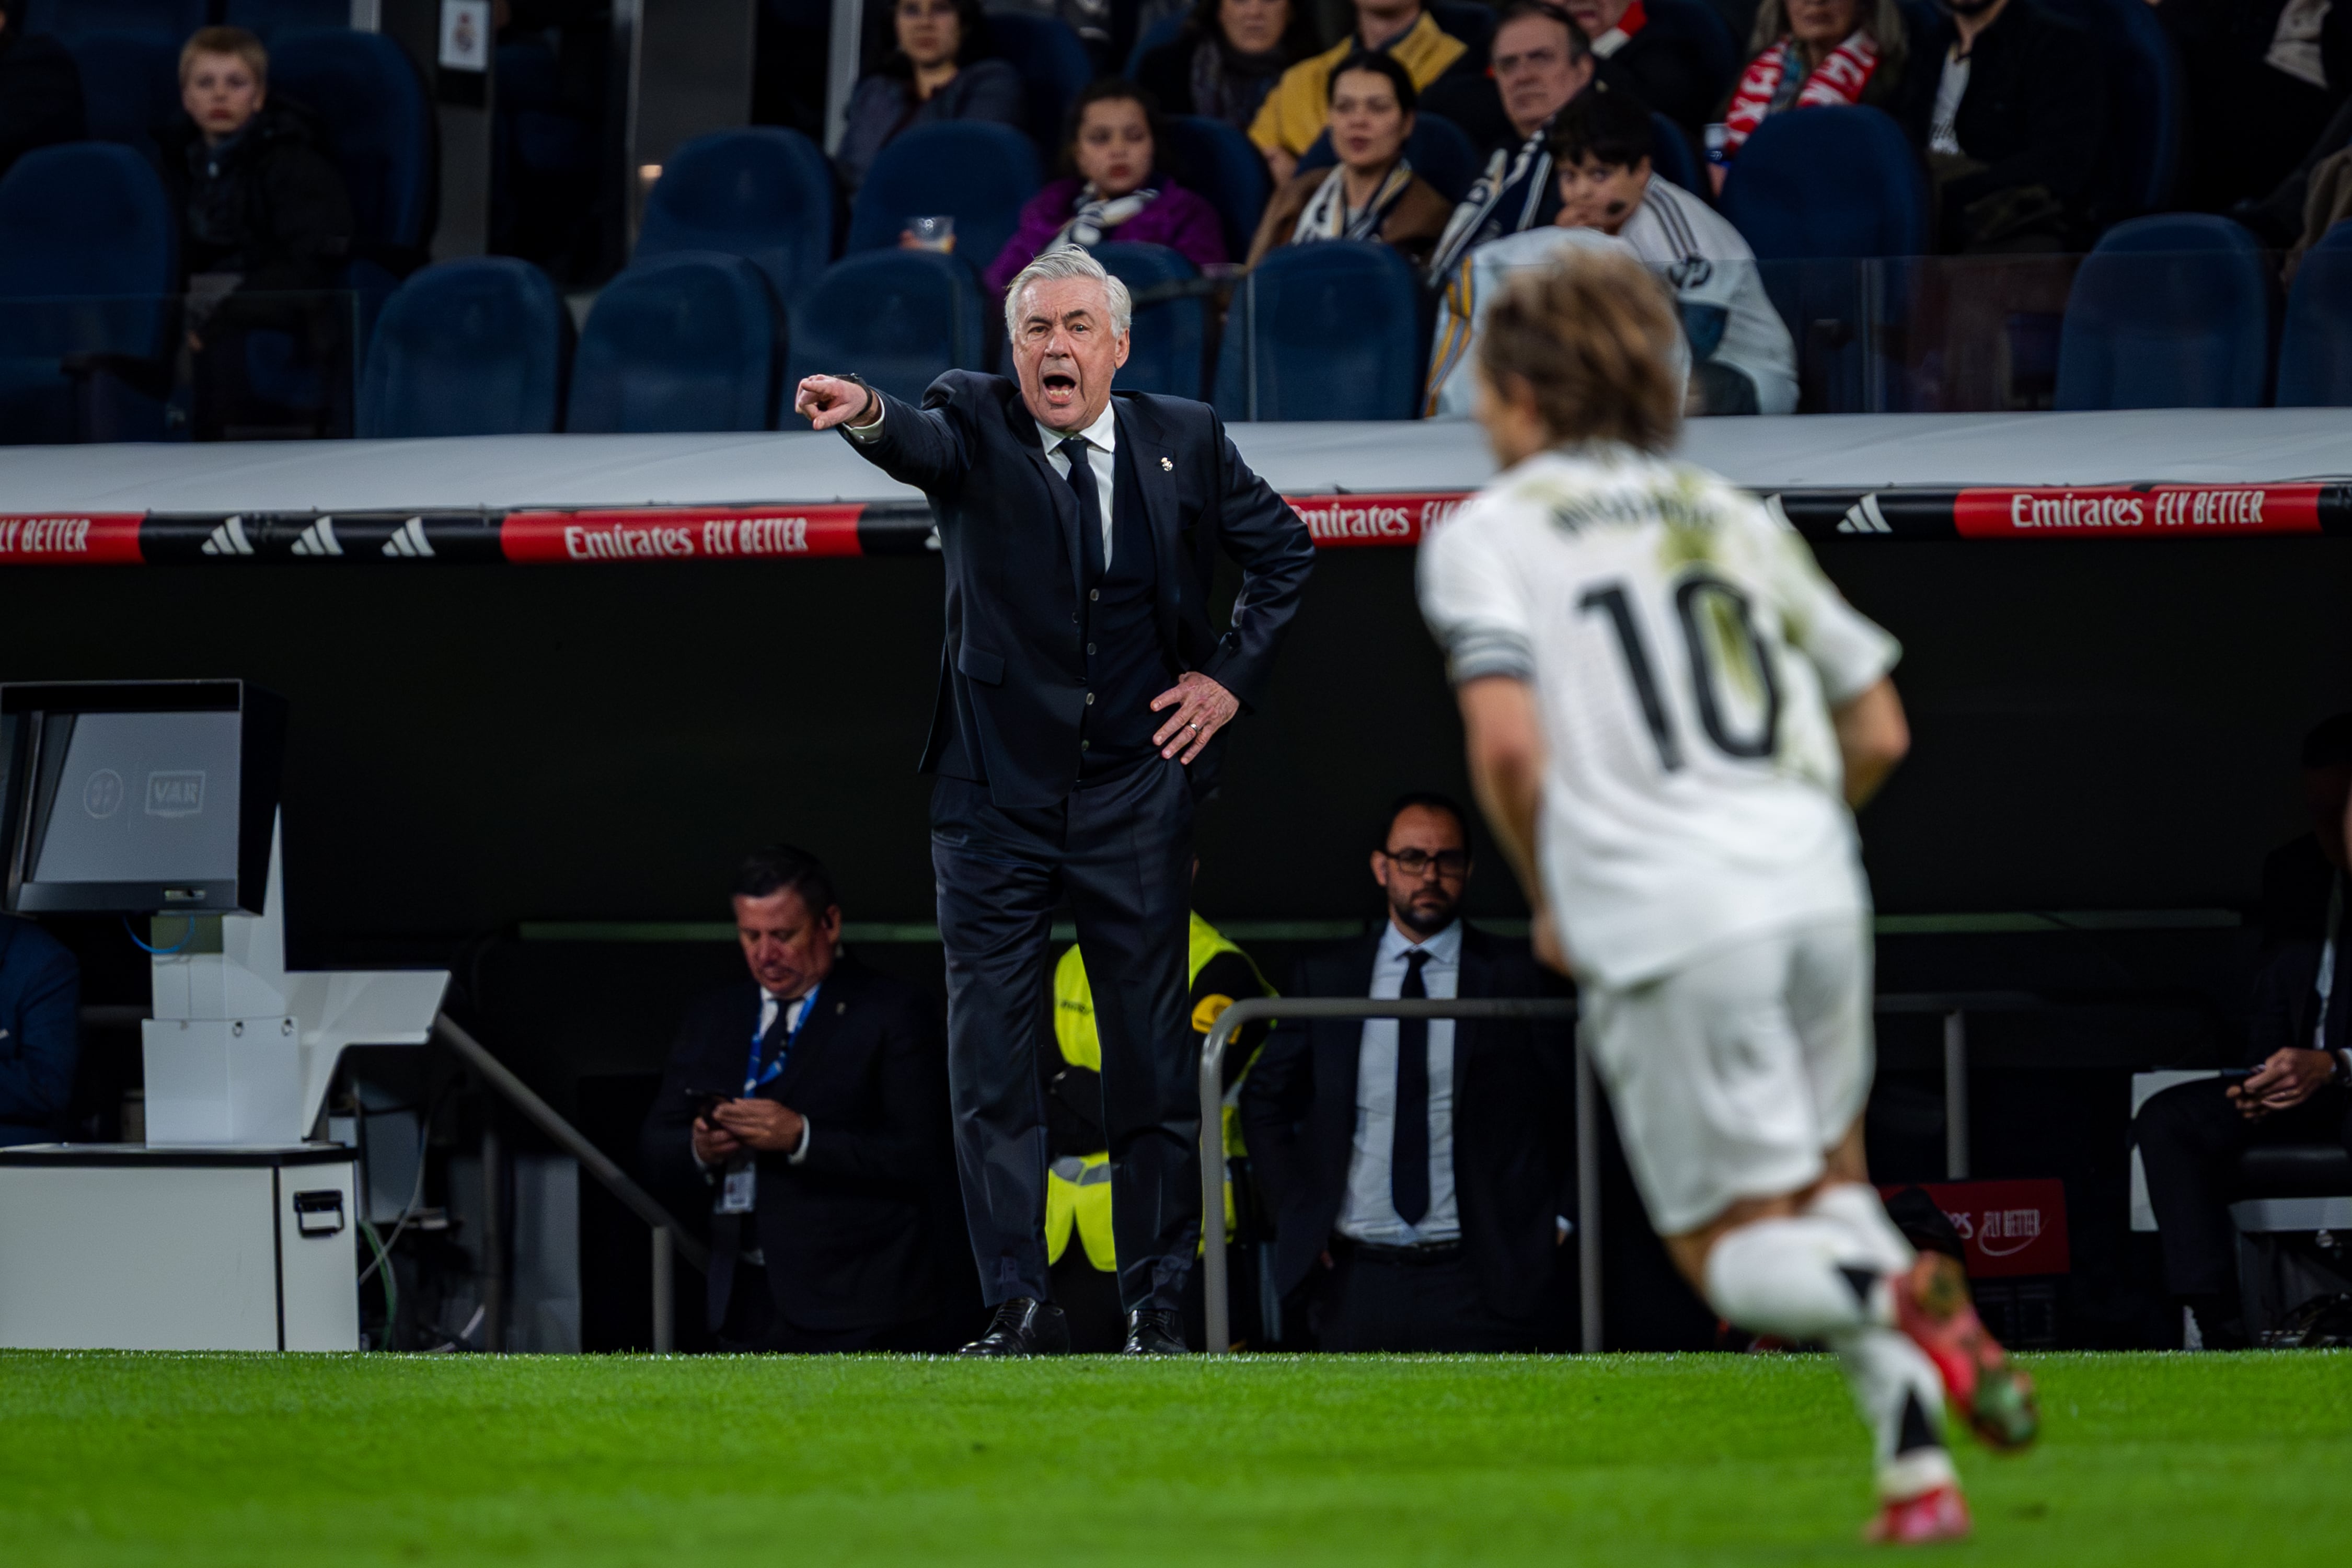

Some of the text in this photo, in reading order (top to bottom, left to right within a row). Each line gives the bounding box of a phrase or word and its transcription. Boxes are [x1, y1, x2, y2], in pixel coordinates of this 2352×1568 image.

[2011, 490, 2266, 528] Emirates FLY BETTER
[21, 518, 91, 553] BETTER
[564, 517, 809, 560] Emirates FLY BETTER
[1576, 571, 1780, 773] 10
